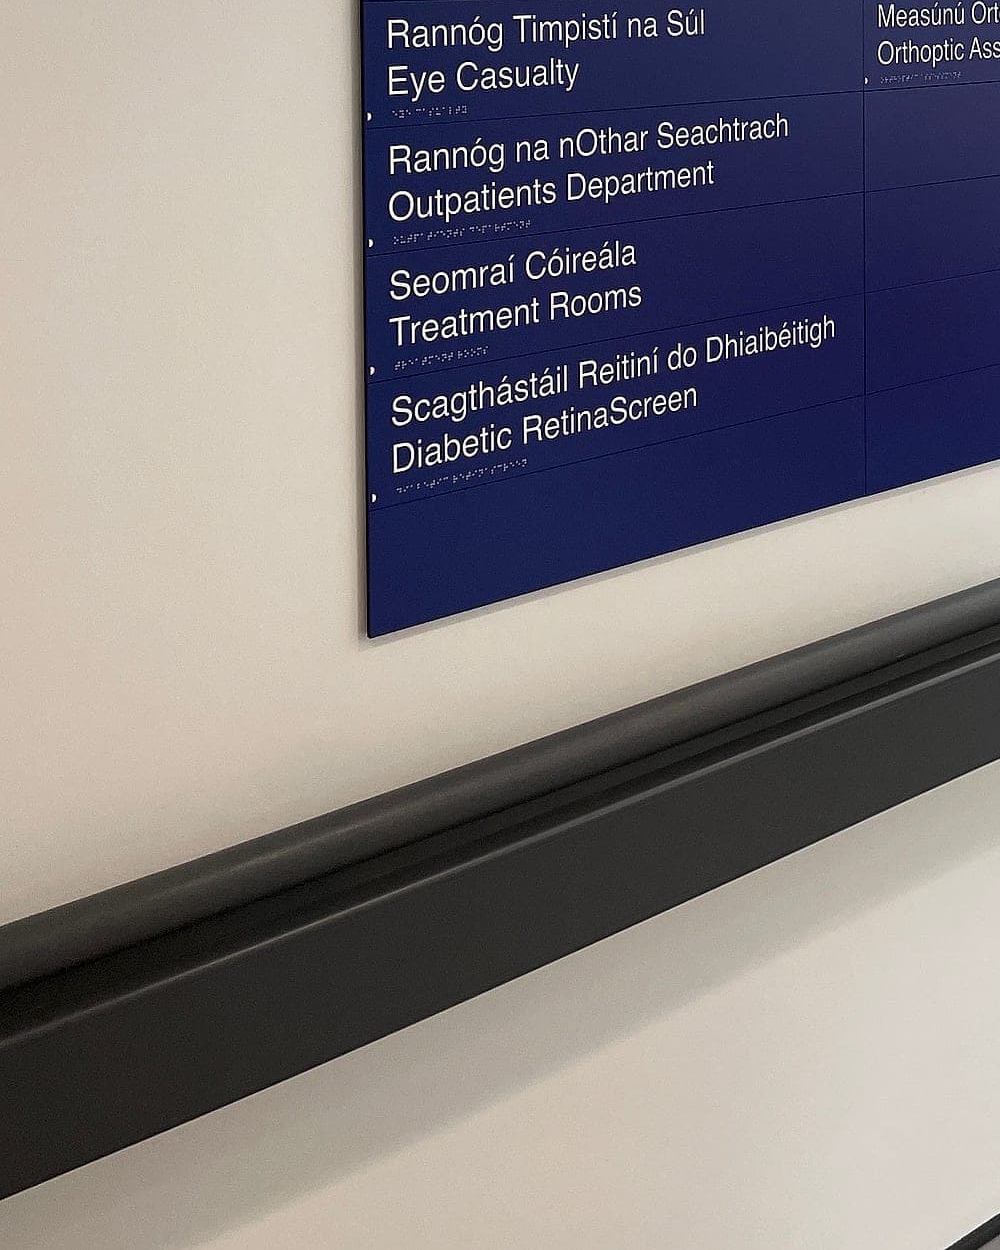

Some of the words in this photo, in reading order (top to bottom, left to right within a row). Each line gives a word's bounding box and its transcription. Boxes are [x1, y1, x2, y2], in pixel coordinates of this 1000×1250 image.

[387, 15, 503, 52] Rannóg
[512, 11, 618, 49] Timpistí
[627, 17, 659, 38] na
[666, 8, 705, 37] Súl
[878, 1, 965, 28] Measúnú
[388, 65, 445, 103] Eye
[456, 57, 580, 92] Casualty
[877, 37, 965, 68] Orthoptic
[389, 137, 505, 175] Rannóg
[516, 139, 550, 163] na
[559, 126, 649, 159] nOthar
[657, 112, 789, 149] Seachtrach
[388, 180, 557, 223] Outpatients
[567, 160, 715, 204] Department
[389, 253, 515, 301] Seomraí
[525, 240, 637, 280] Cóireála
[388, 297, 540, 347] Treatment
[550, 286, 642, 321] Rooms
[391, 364, 569, 424] Scagthástáil
[579, 346, 659, 389] Reitiní
[667, 342, 697, 371] do
[706, 314, 835, 363] Dhiaibéitigh
[393, 423, 512, 474] Diabetic
[523, 387, 697, 445] RetinaScreen
